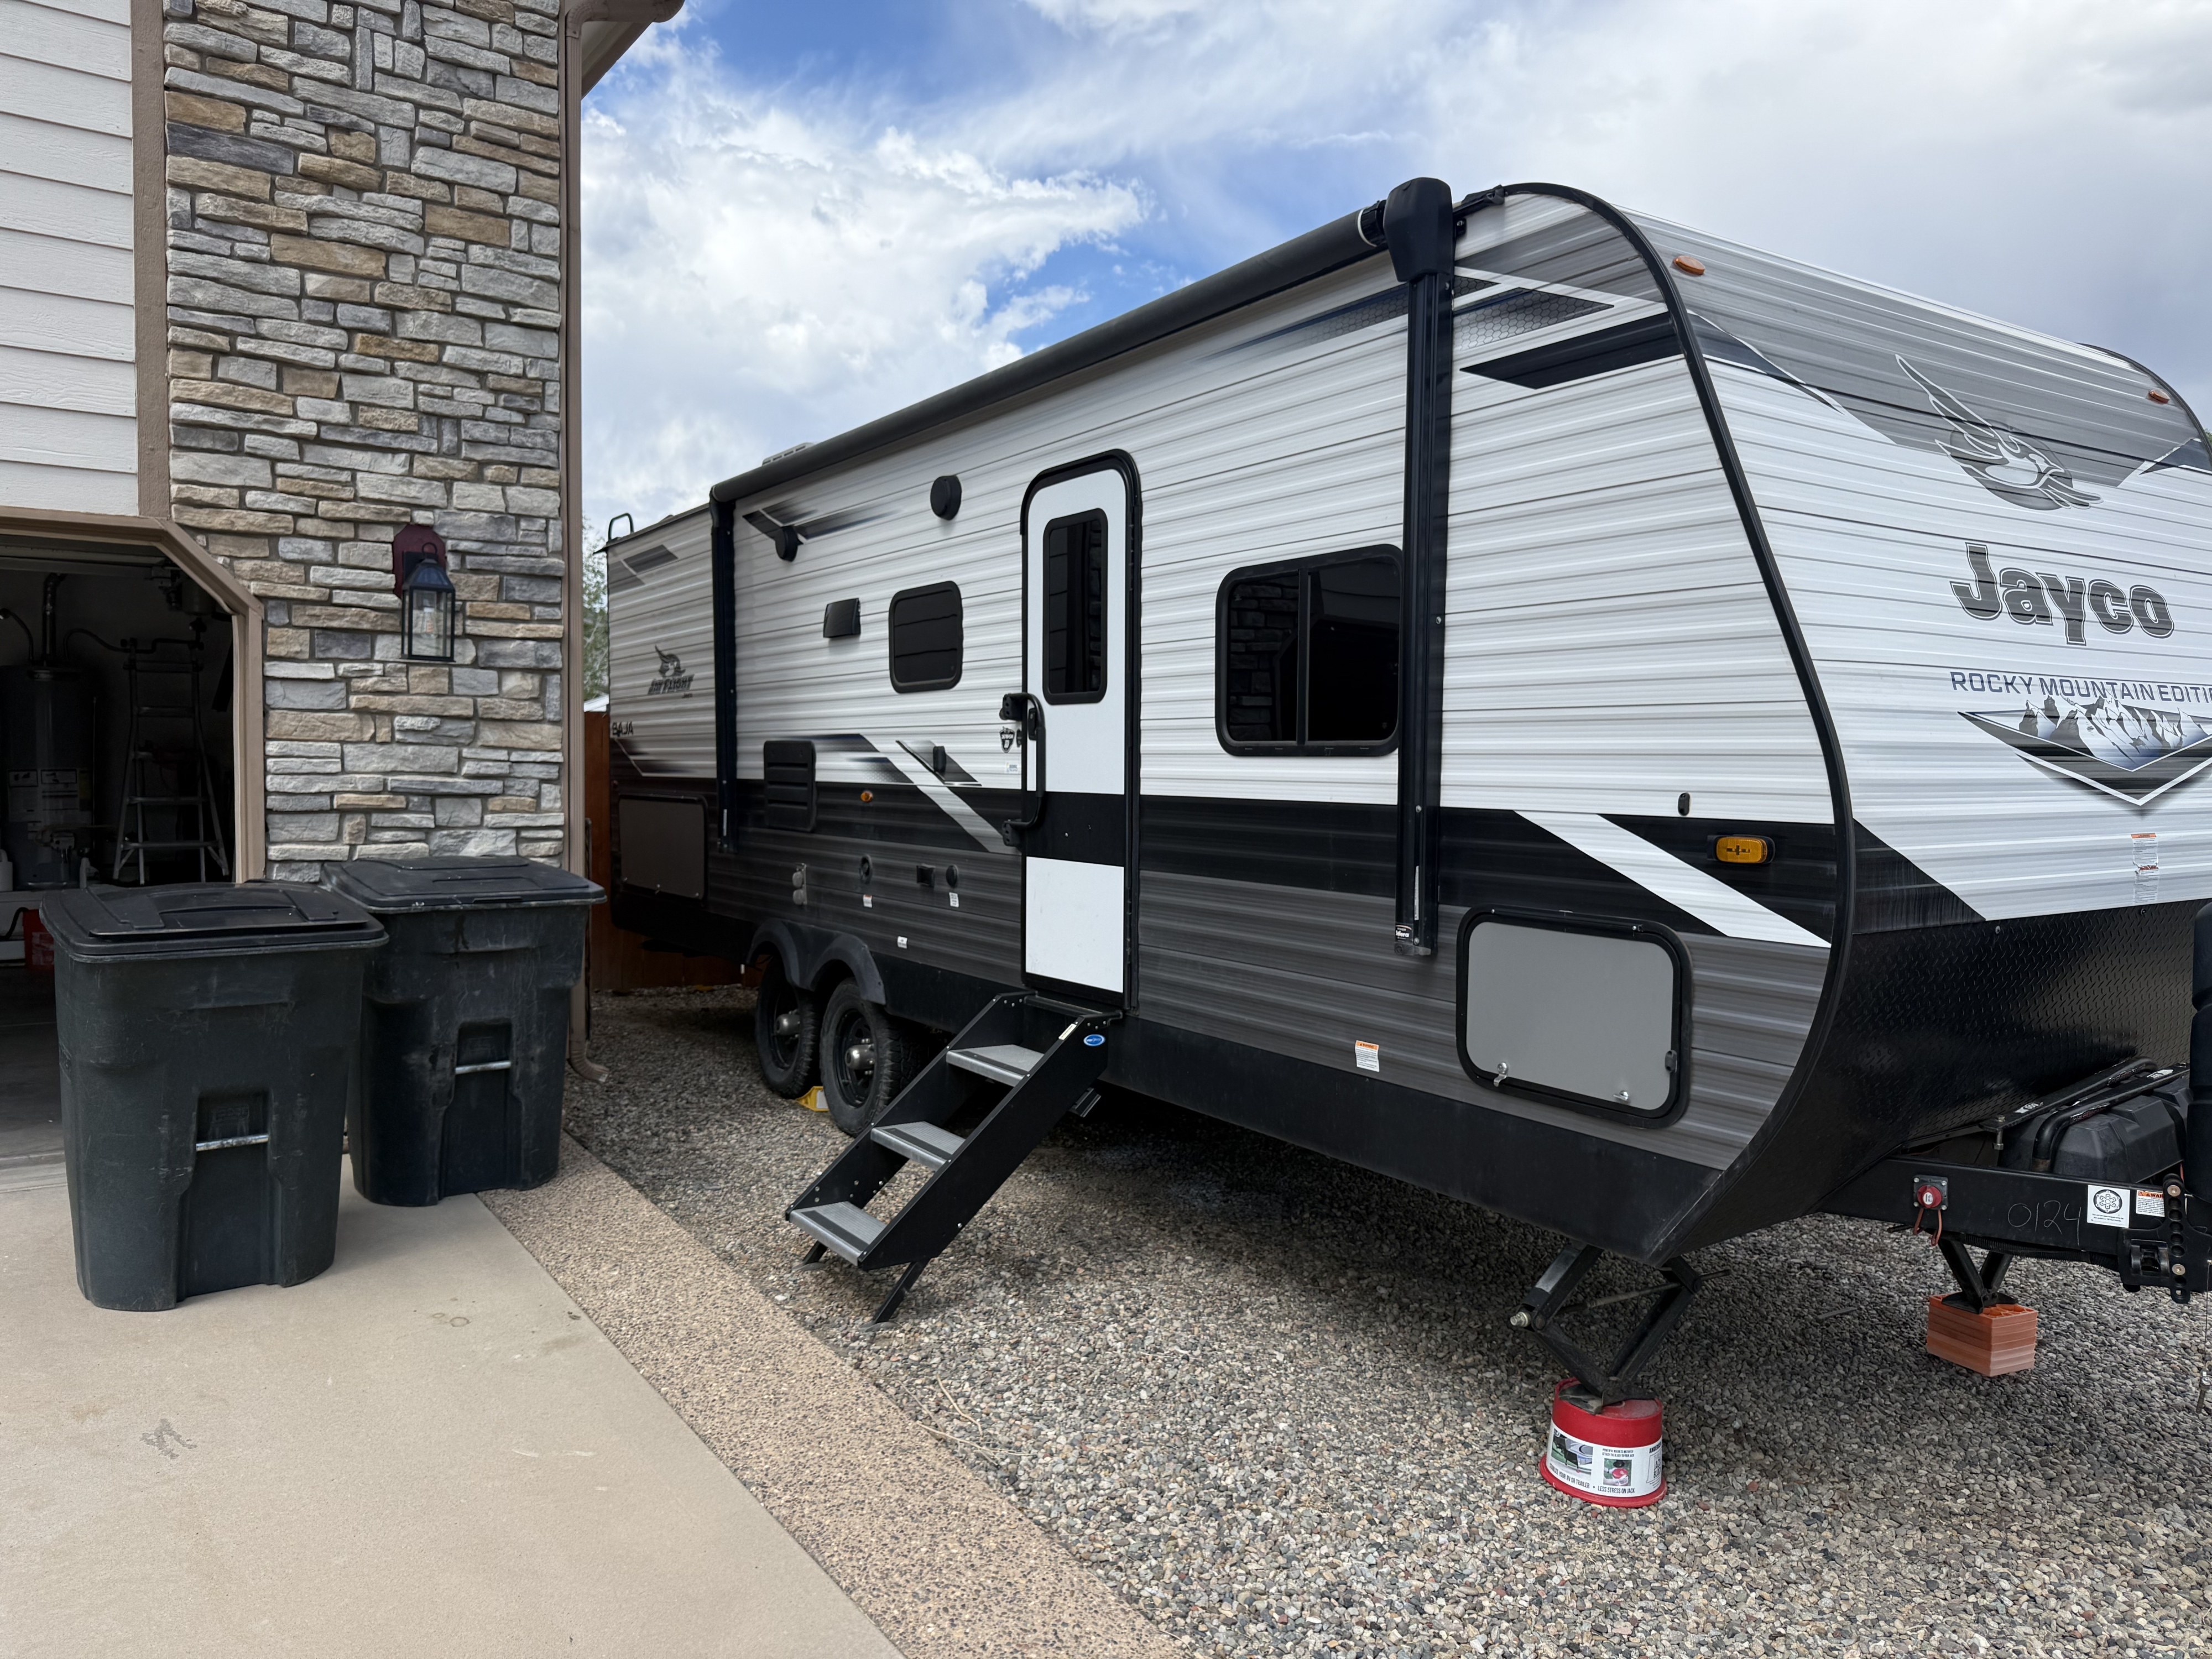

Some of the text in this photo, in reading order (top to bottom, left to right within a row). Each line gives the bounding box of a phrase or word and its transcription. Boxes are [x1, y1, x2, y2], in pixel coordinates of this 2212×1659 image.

[1949, 542, 2174, 646] Jayco
[661, 674, 695, 693] FLIGHT
[1950, 671, 2212, 703] ROCKY MOUNTAIN EDITI
[612, 721, 634, 737] BAJA
[2008, 1200, 2081, 1246] 0124
[1576, 1479, 1590, 1489] TRAILER
